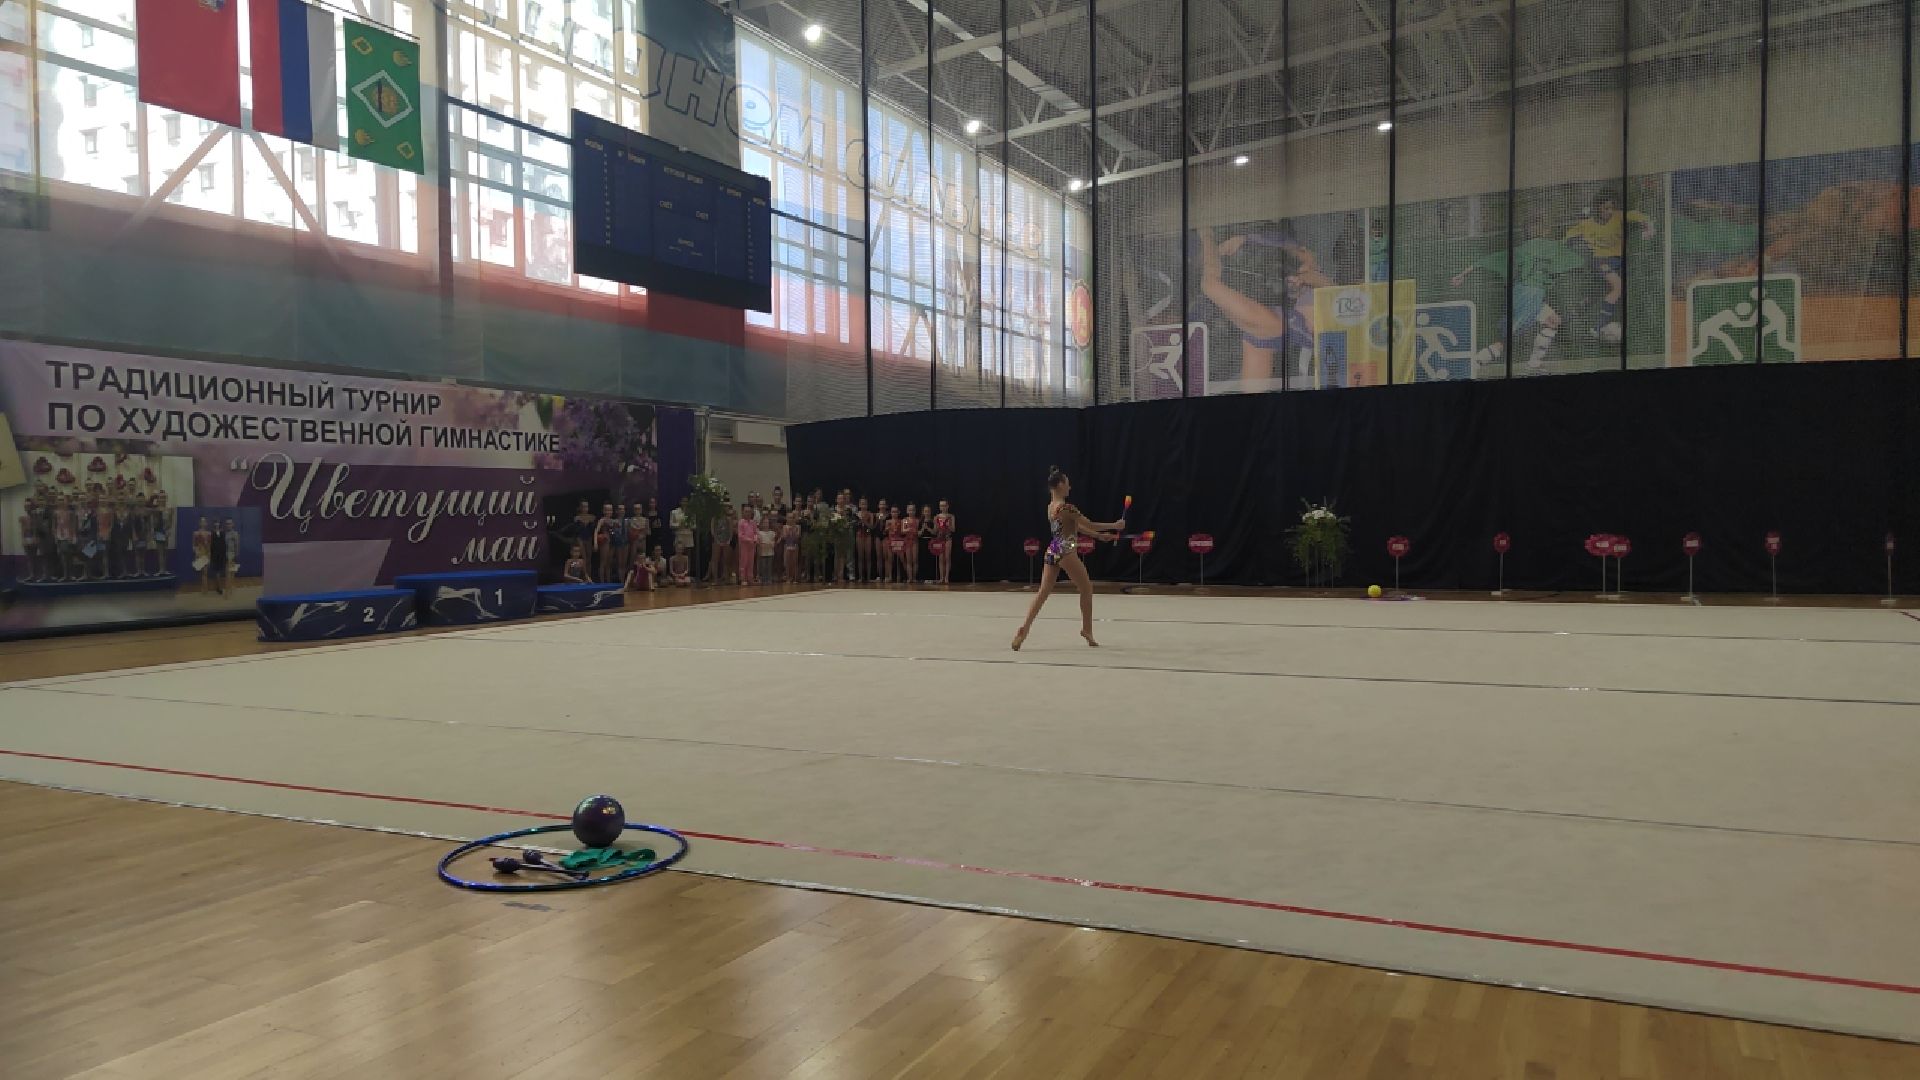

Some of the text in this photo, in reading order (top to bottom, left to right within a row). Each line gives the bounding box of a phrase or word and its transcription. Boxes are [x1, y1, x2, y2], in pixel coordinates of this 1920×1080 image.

[45, 360, 442, 416] ТРАДИЦИОННЫЙ ТУРНИР
[49, 402, 560, 454] ПО ХУДОЖЕСТВЕННОЙ ГИМНАСТИКЕ
[494, 588, 503, 605] 1
[363, 606, 376, 623] 2
